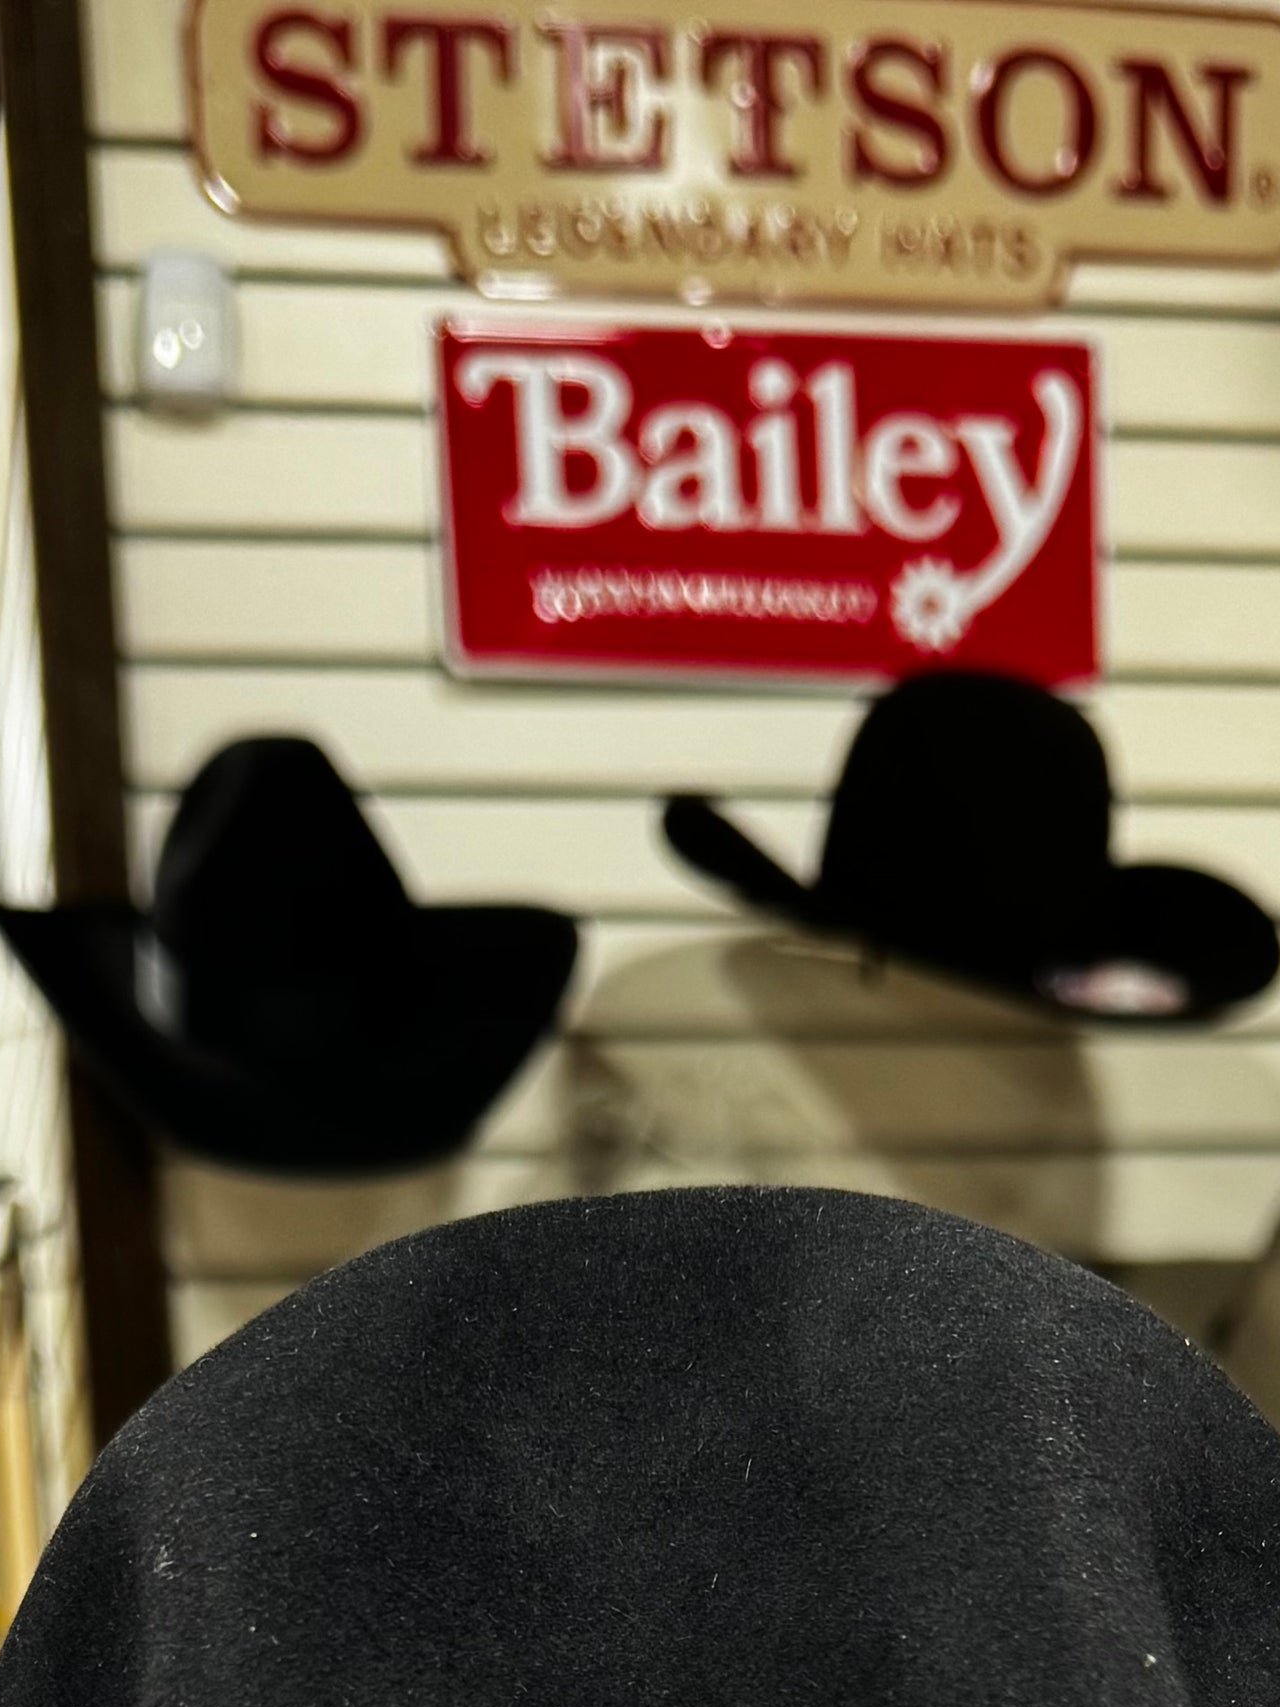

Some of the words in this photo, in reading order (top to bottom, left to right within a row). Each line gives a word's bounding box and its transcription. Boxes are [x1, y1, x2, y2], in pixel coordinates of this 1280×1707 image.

[252, 10, 1254, 206] STETSON
[878, 208, 1042, 282] HATS
[455, 354, 1082, 622] Bailey
